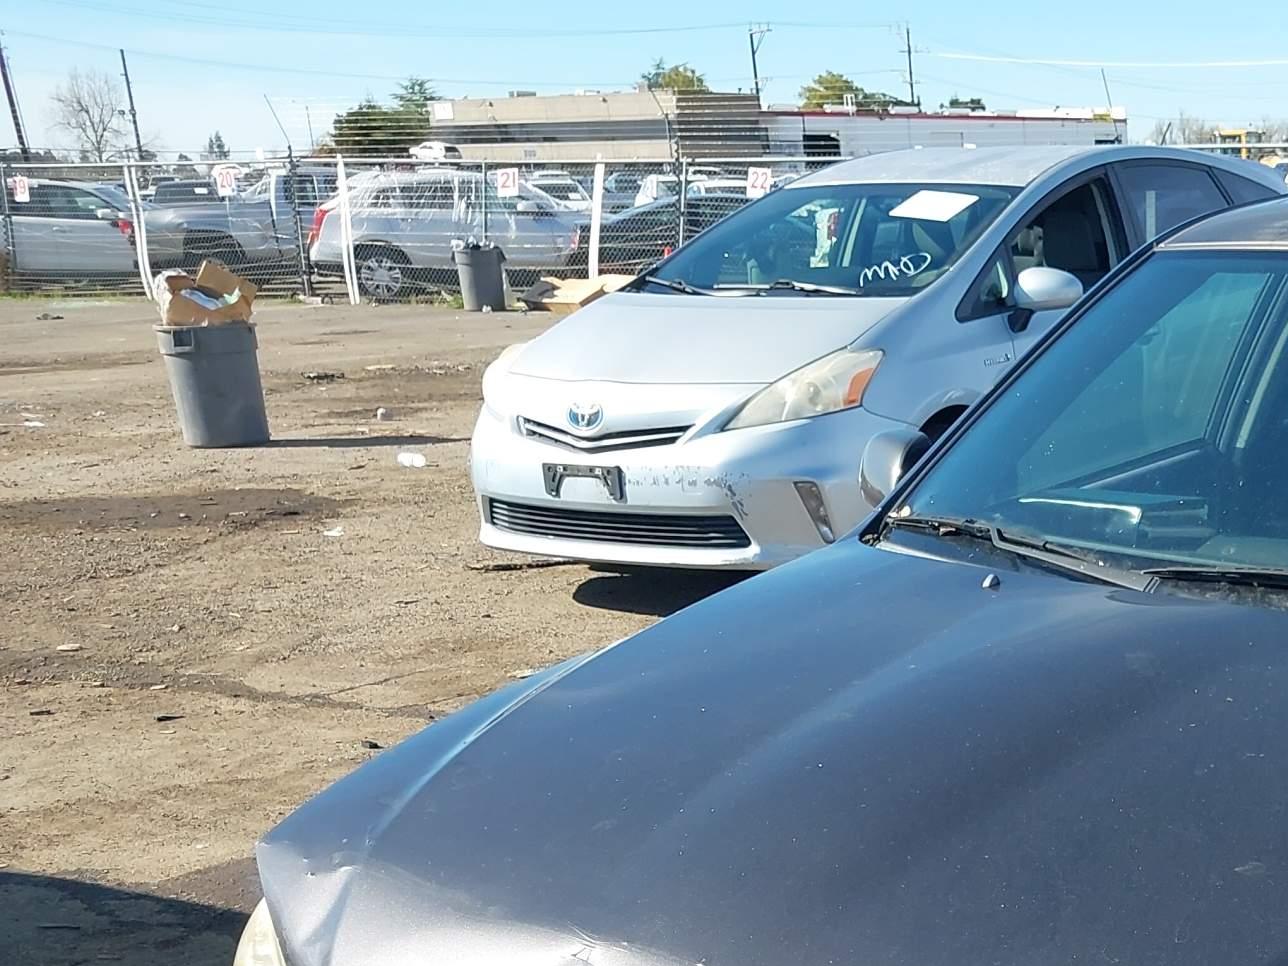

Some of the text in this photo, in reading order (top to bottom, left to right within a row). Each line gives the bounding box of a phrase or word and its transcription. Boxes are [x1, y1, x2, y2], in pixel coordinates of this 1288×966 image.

[218, 171, 233, 188] 20
[500, 171, 516, 188] 21
[751, 171, 768, 189] 22
